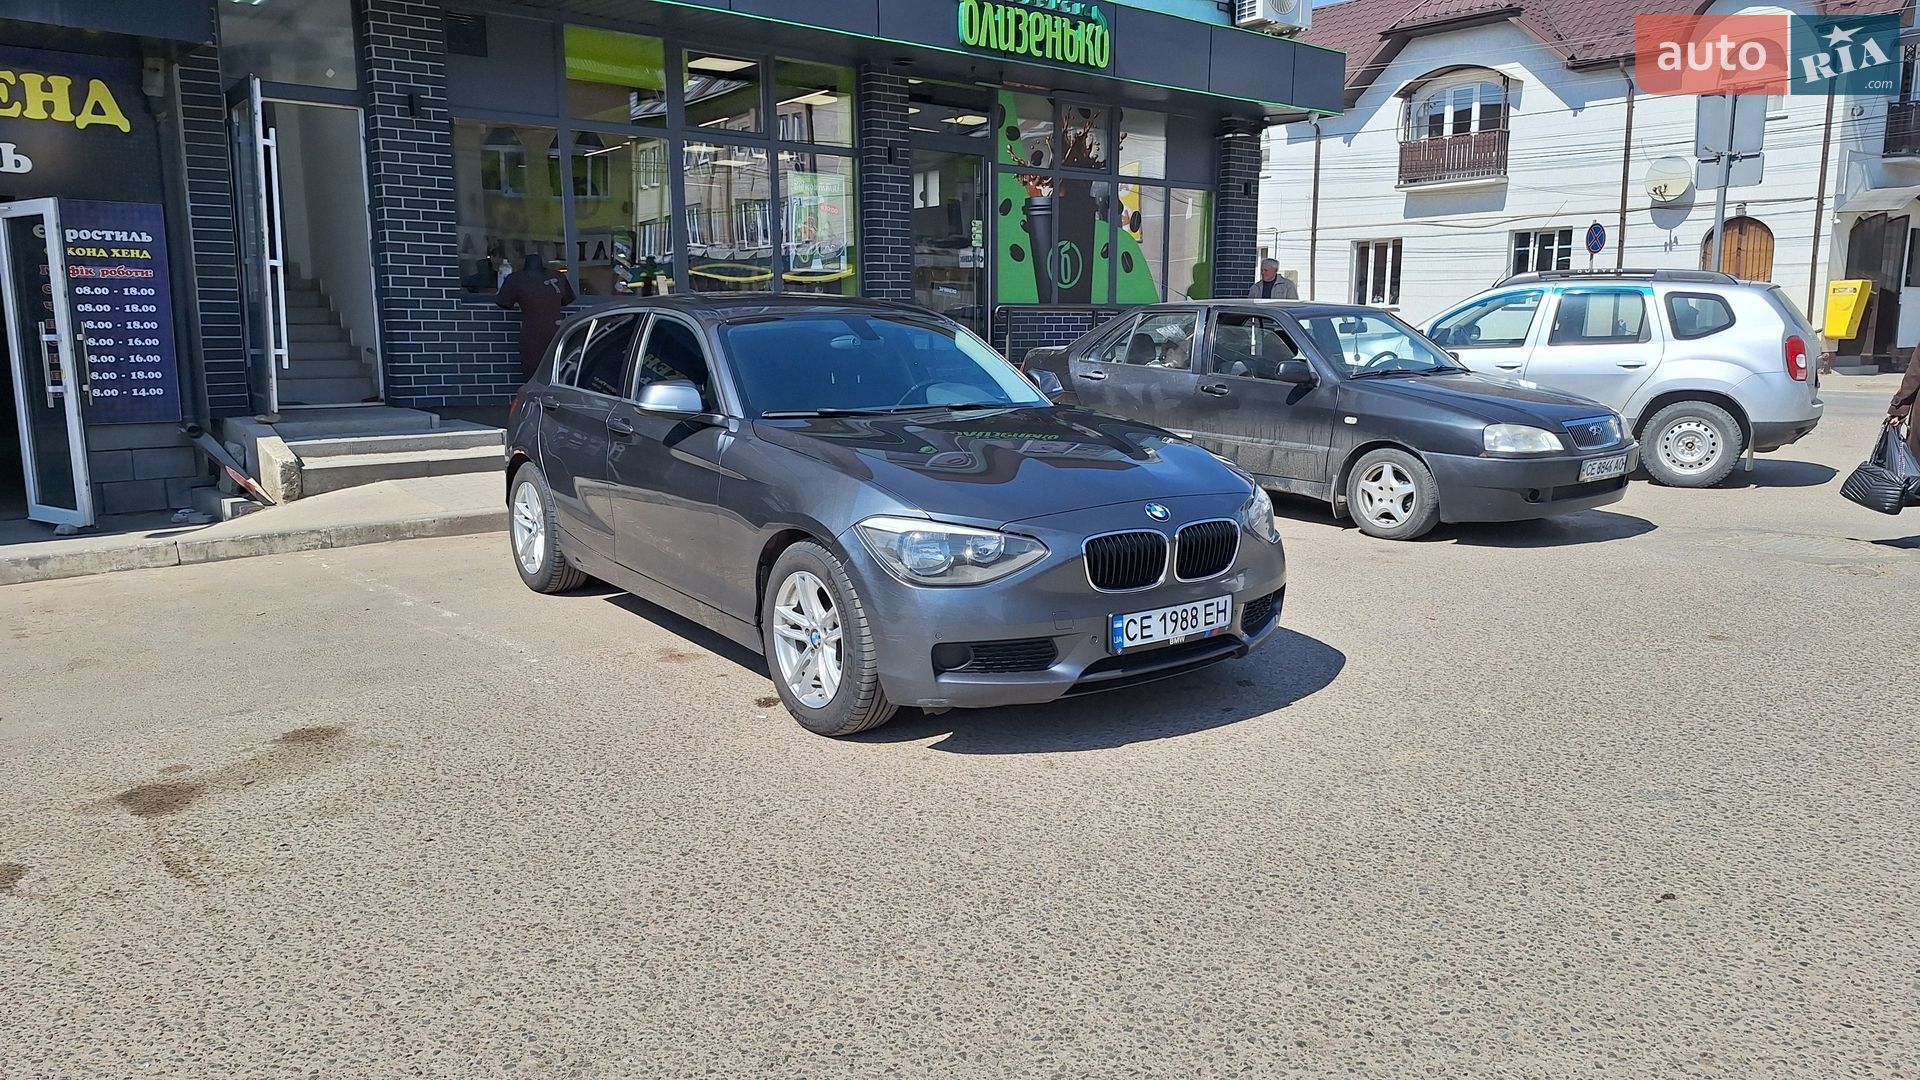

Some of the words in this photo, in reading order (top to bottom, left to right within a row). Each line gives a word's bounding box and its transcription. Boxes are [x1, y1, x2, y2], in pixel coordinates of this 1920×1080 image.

[110, 248, 152, 259] ХЕНД
[100, 265, 154, 277] роботи:
[75, 286, 109, 295] 08.00
[123, 287, 155, 296] 18.00
[76, 304, 111, 312] 08.00
[124, 304, 157, 313] 18.00
[126, 321, 158, 329] 18.00
[86, 337, 114, 346] 8.00
[127, 338, 160, 346] 16.00
[88, 354, 115, 363] 8.00
[129, 354, 161, 363] 16.00
[90, 371, 117, 380] 8.00
[130, 371, 162, 379] 18.00
[92, 388, 119, 397] 8.00
[132, 388, 164, 397] 14.00
[1586, 463, 1597, 476] CE
[1125, 615, 1153, 641] CE
[1159, 606, 1199, 635] 1988
[1203, 600, 1228, 626] EH
[1113, 636, 1123, 644] UA
[1169, 636, 1186, 645] BMW
